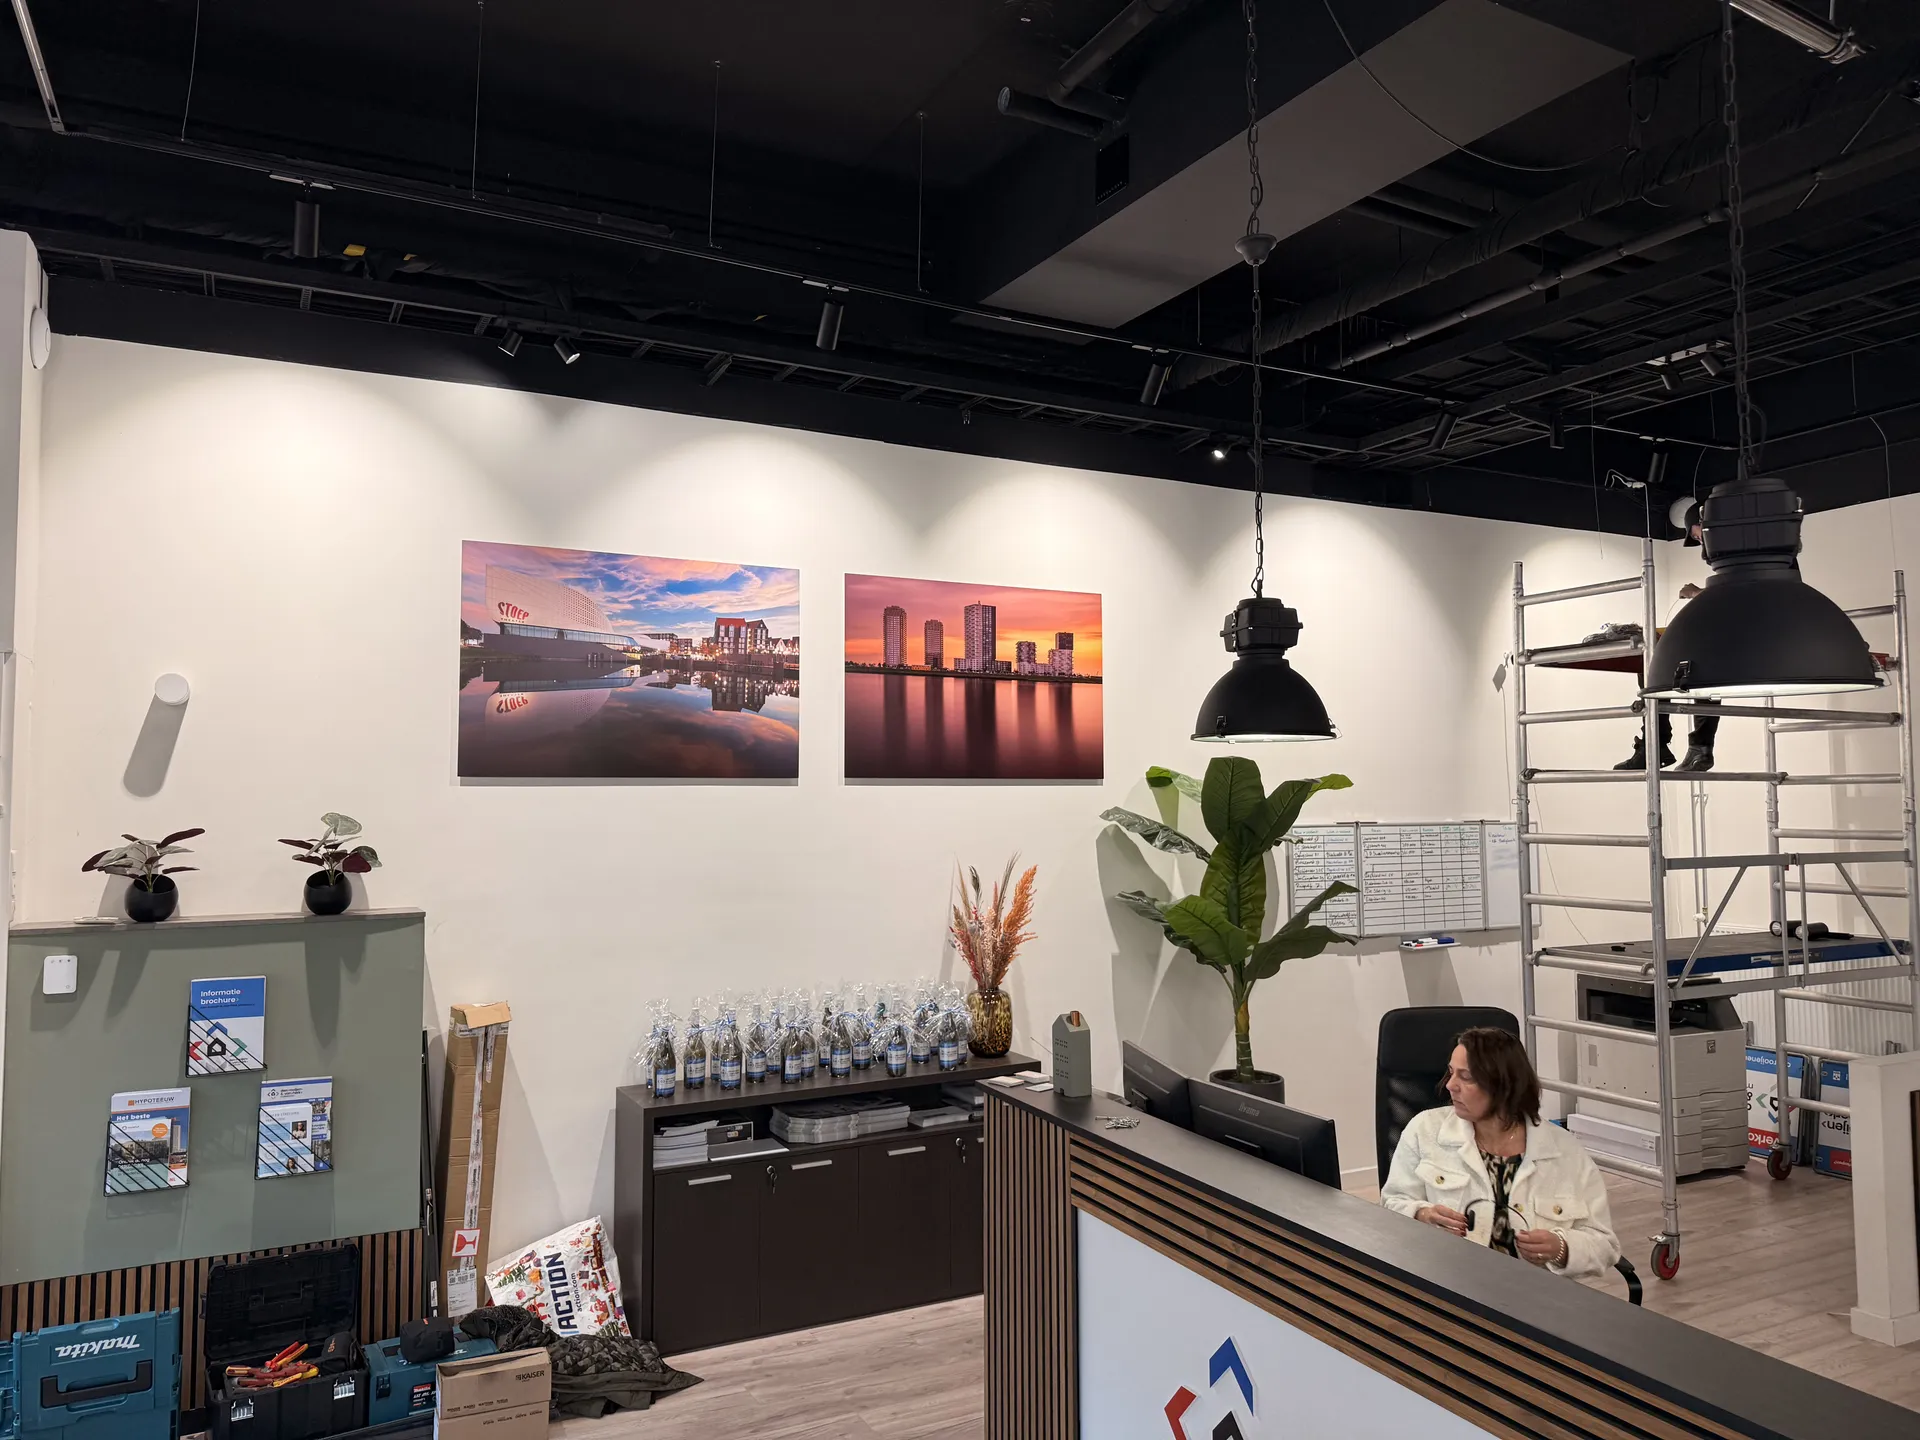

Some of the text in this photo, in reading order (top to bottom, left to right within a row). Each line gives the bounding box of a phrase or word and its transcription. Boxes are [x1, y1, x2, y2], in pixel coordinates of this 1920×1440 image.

[498, 602, 529, 620] STOEP
[201, 989, 241, 997] Informatie
[1748, 1132, 1780, 1148] Verko
[543, 1252, 578, 1330] ACTION
[571, 1272, 583, 1313] action.com
[521, 1370, 545, 1381] KAISER
